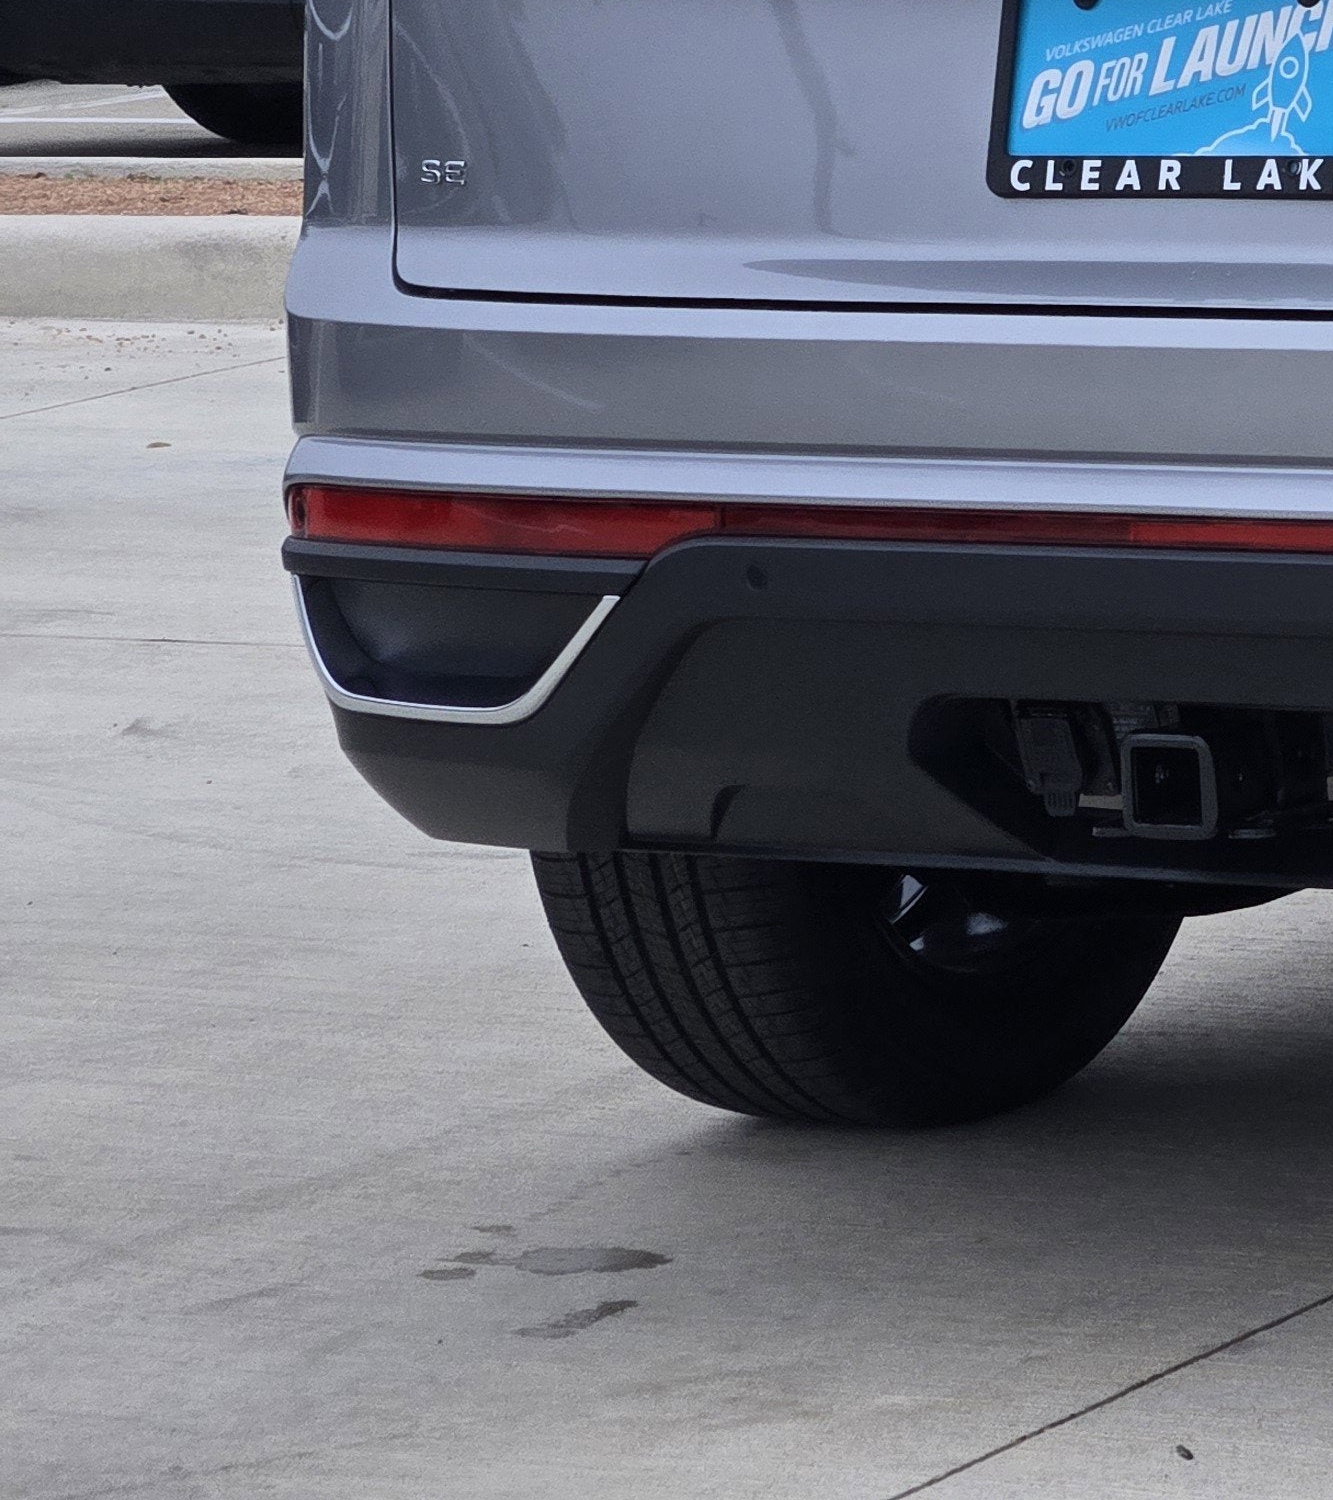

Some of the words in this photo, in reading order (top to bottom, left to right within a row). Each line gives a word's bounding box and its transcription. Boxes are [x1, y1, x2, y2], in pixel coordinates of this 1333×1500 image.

[1044, 22, 1144, 62] VOLKSWAGEN
[1147, 9, 1193, 34] CLEAR
[1021, 58, 1095, 131] GO
[1092, 51, 1149, 107] FOR
[1105, 83, 1247, 133] VWOFCLEARLAKE.COM
[420, 159, 467, 186] SE
[1010, 158, 1182, 193] CLEAR
